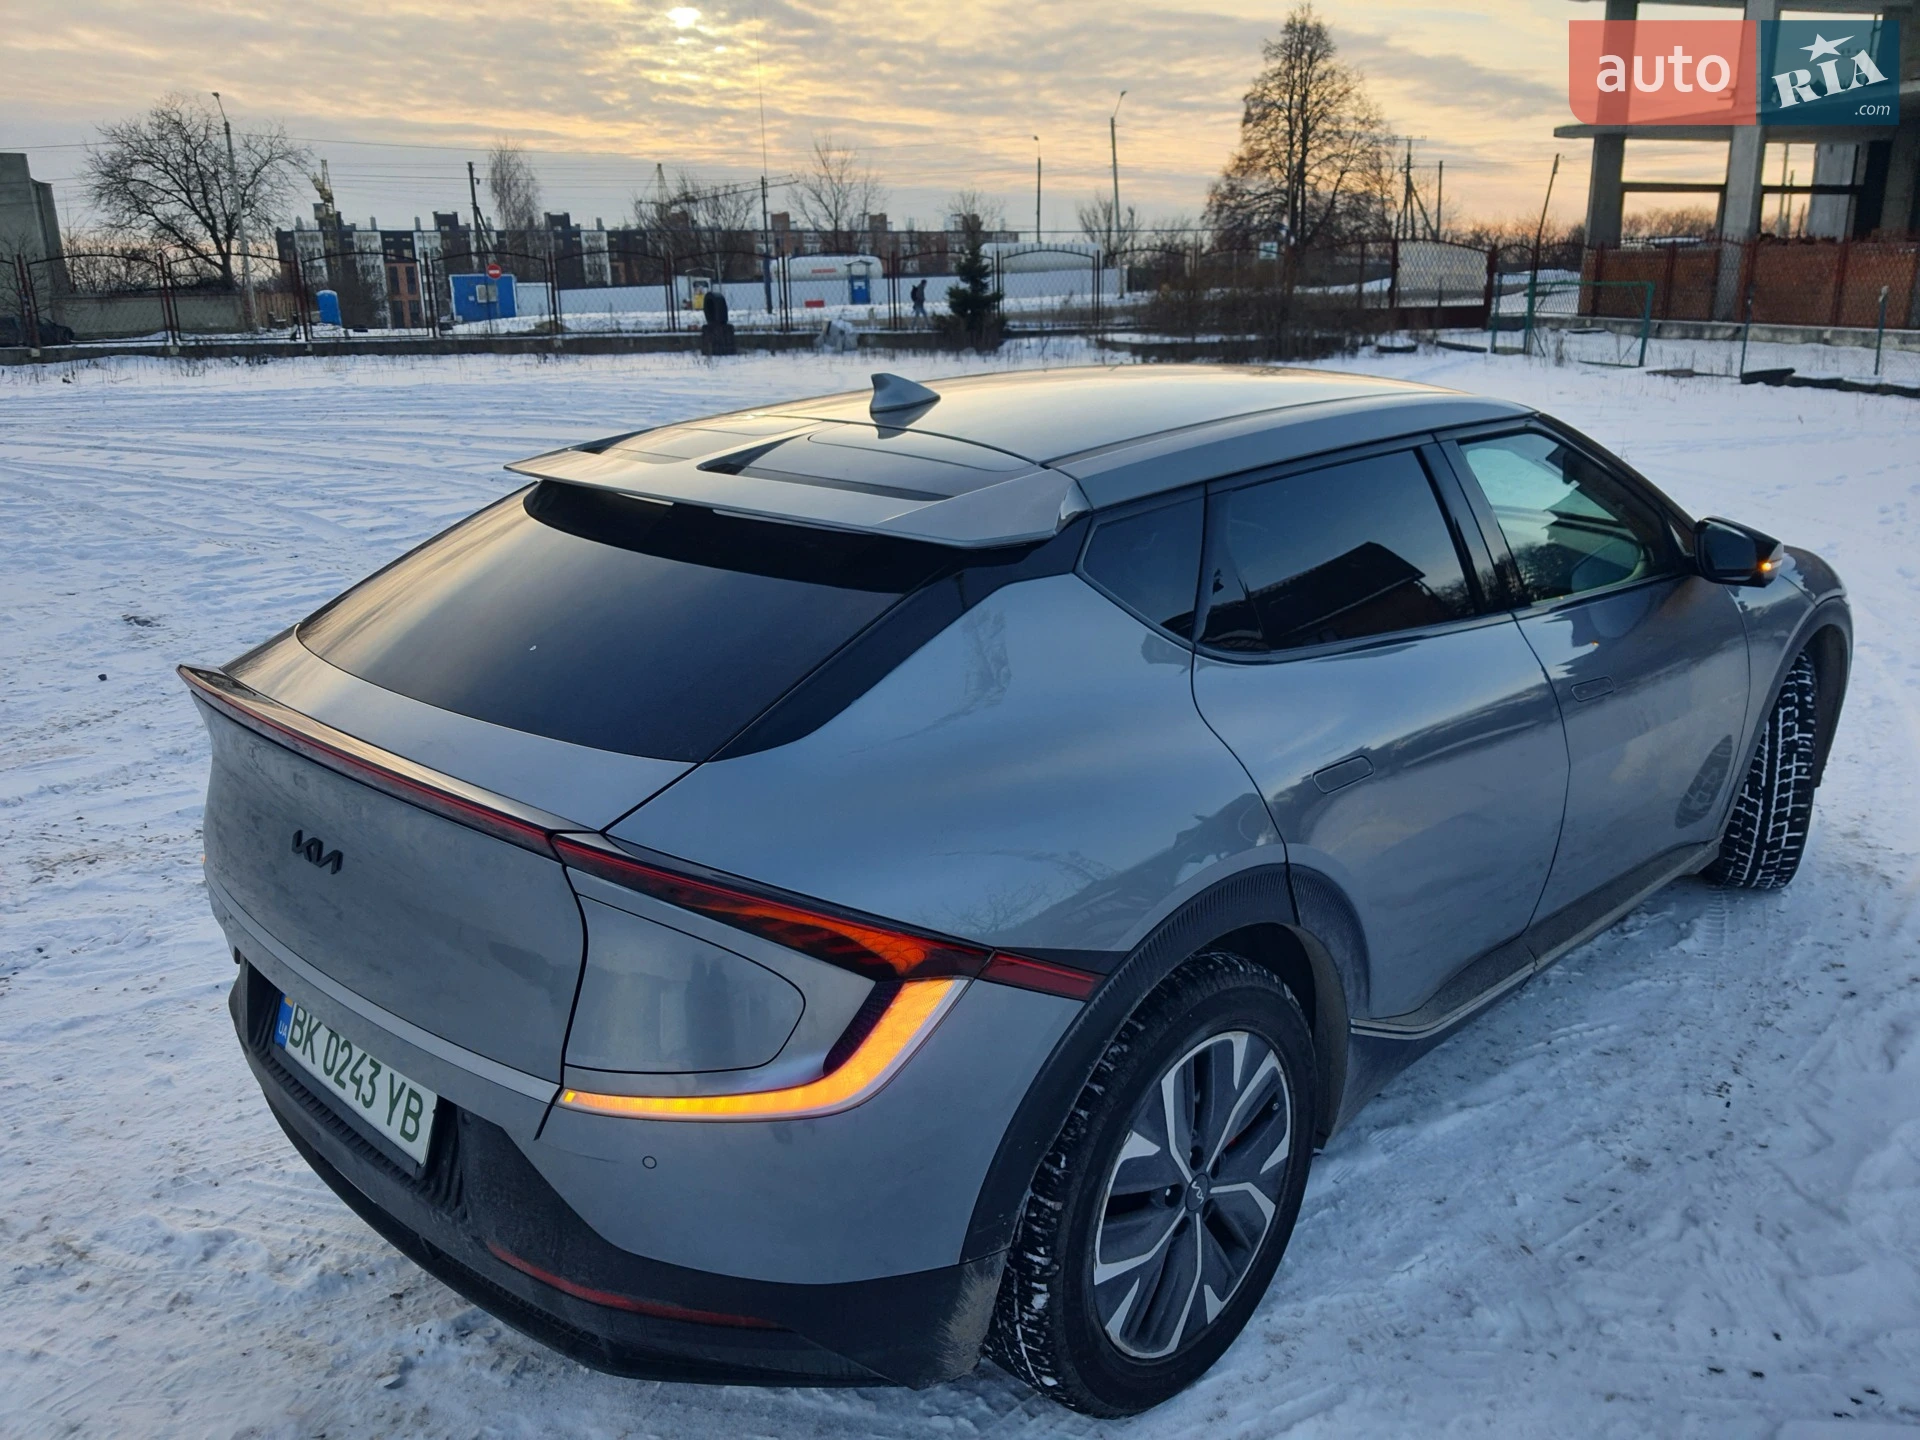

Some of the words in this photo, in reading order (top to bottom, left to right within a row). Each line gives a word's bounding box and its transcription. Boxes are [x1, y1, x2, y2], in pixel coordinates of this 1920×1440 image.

[292, 830, 344, 875] KIA
[278, 1020, 288, 1040] UA
[289, 1004, 322, 1065] BK
[322, 1030, 382, 1109] 0243
[386, 1072, 424, 1143] YB
